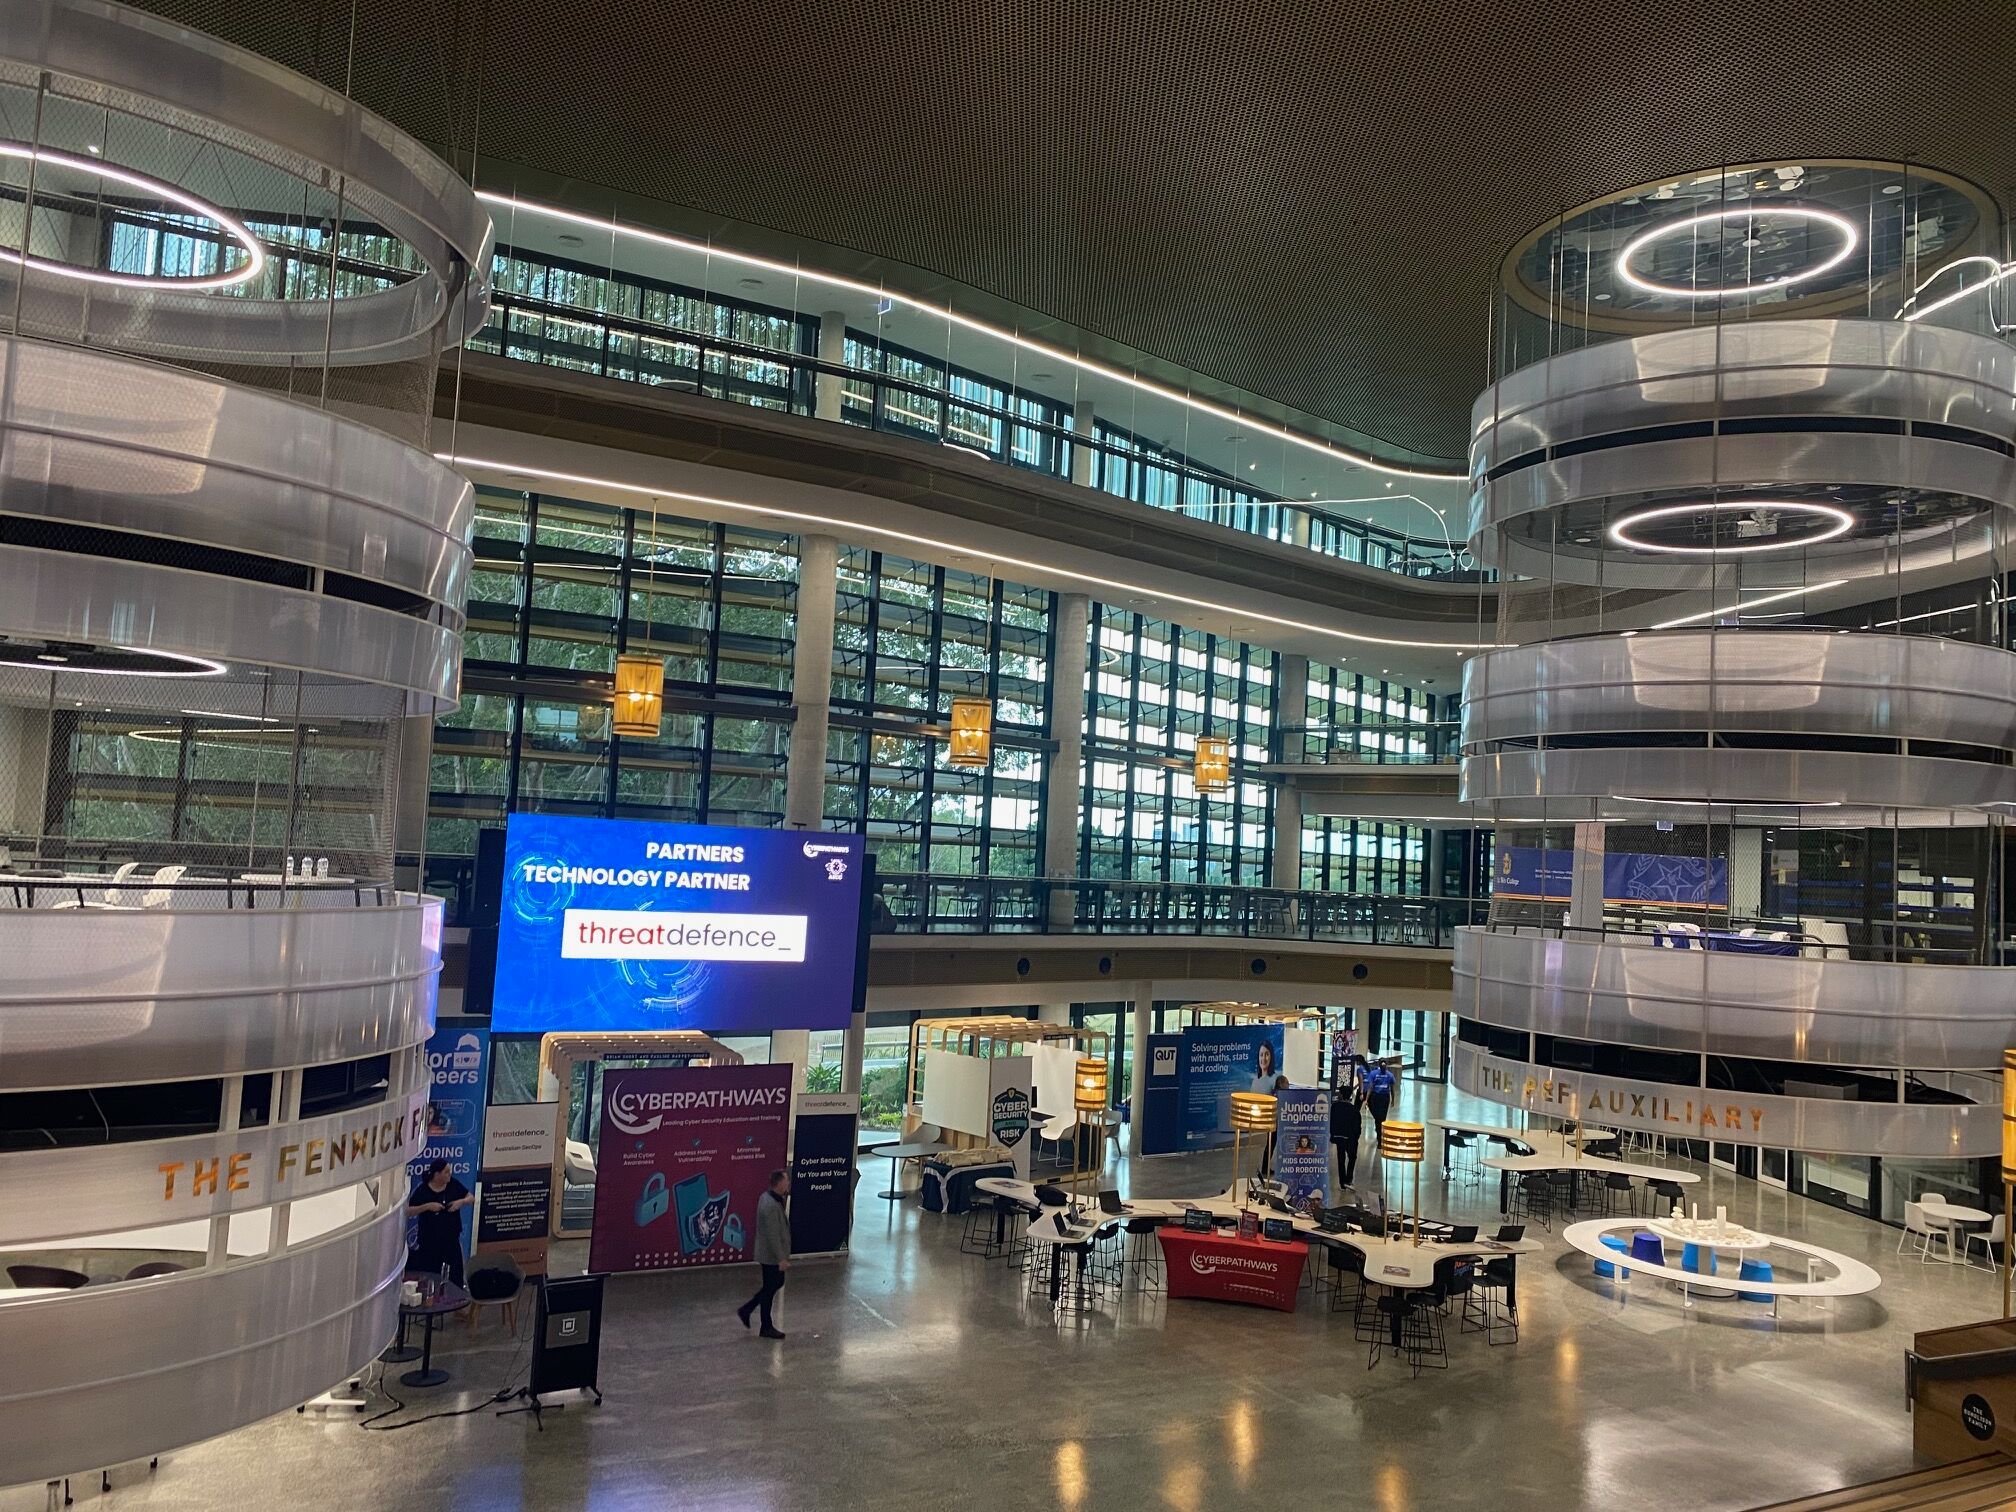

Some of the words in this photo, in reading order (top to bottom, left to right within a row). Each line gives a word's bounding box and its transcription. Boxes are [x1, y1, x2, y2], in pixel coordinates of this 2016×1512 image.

[646, 842, 745, 863] PARTNERS
[523, 865, 661, 887] TECHNOLOGY
[664, 873, 750, 891] PARTNER
[1191, 1043, 1218, 1054] Solving
[1219, 1042, 1251, 1053] problems
[423, 1049, 453, 1068] ior
[1156, 1050, 1175, 1061] QUT
[1190, 1053, 1206, 1062] with
[1207, 1053, 1231, 1062] maths,
[1232, 1052, 1249, 1061] stats
[1190, 1064, 1204, 1073] and
[1205, 1063, 1229, 1074] coding
[620, 1087, 786, 1111] CYBERPATHWAYS
[1483, 1066, 1515, 1094] THE
[1588, 1089, 1765, 1131] AUXILIARY
[994, 1101, 1028, 1112] CYBER
[1281, 1102, 1314, 1112] Junior
[662, 1119, 684, 1127] Leading
[684, 1118, 701, 1126] Cyber
[701, 1117, 722, 1125] Security
[760, 1114, 781, 1122] Training
[994, 1111, 1028, 1119] SECURITY
[1281, 1113, 1329, 1124] Engineers
[1000, 1129, 1020, 1139] RISK
[158, 1153, 252, 1201] THE
[278, 1115, 404, 1182] FENWICK
[678, 1155, 713, 1163] Vulnerability
[801, 1158, 819, 1166] Cyber
[820, 1157, 846, 1165] Security
[1283, 1157, 1298, 1165] KIDS
[1299, 1157, 1325, 1165] CODING
[1280, 1166, 1295, 1174] AND
[1295, 1166, 1329, 1174] ROBOTICS
[1196, 1255, 1278, 1272] CYBERPATHWAYS
